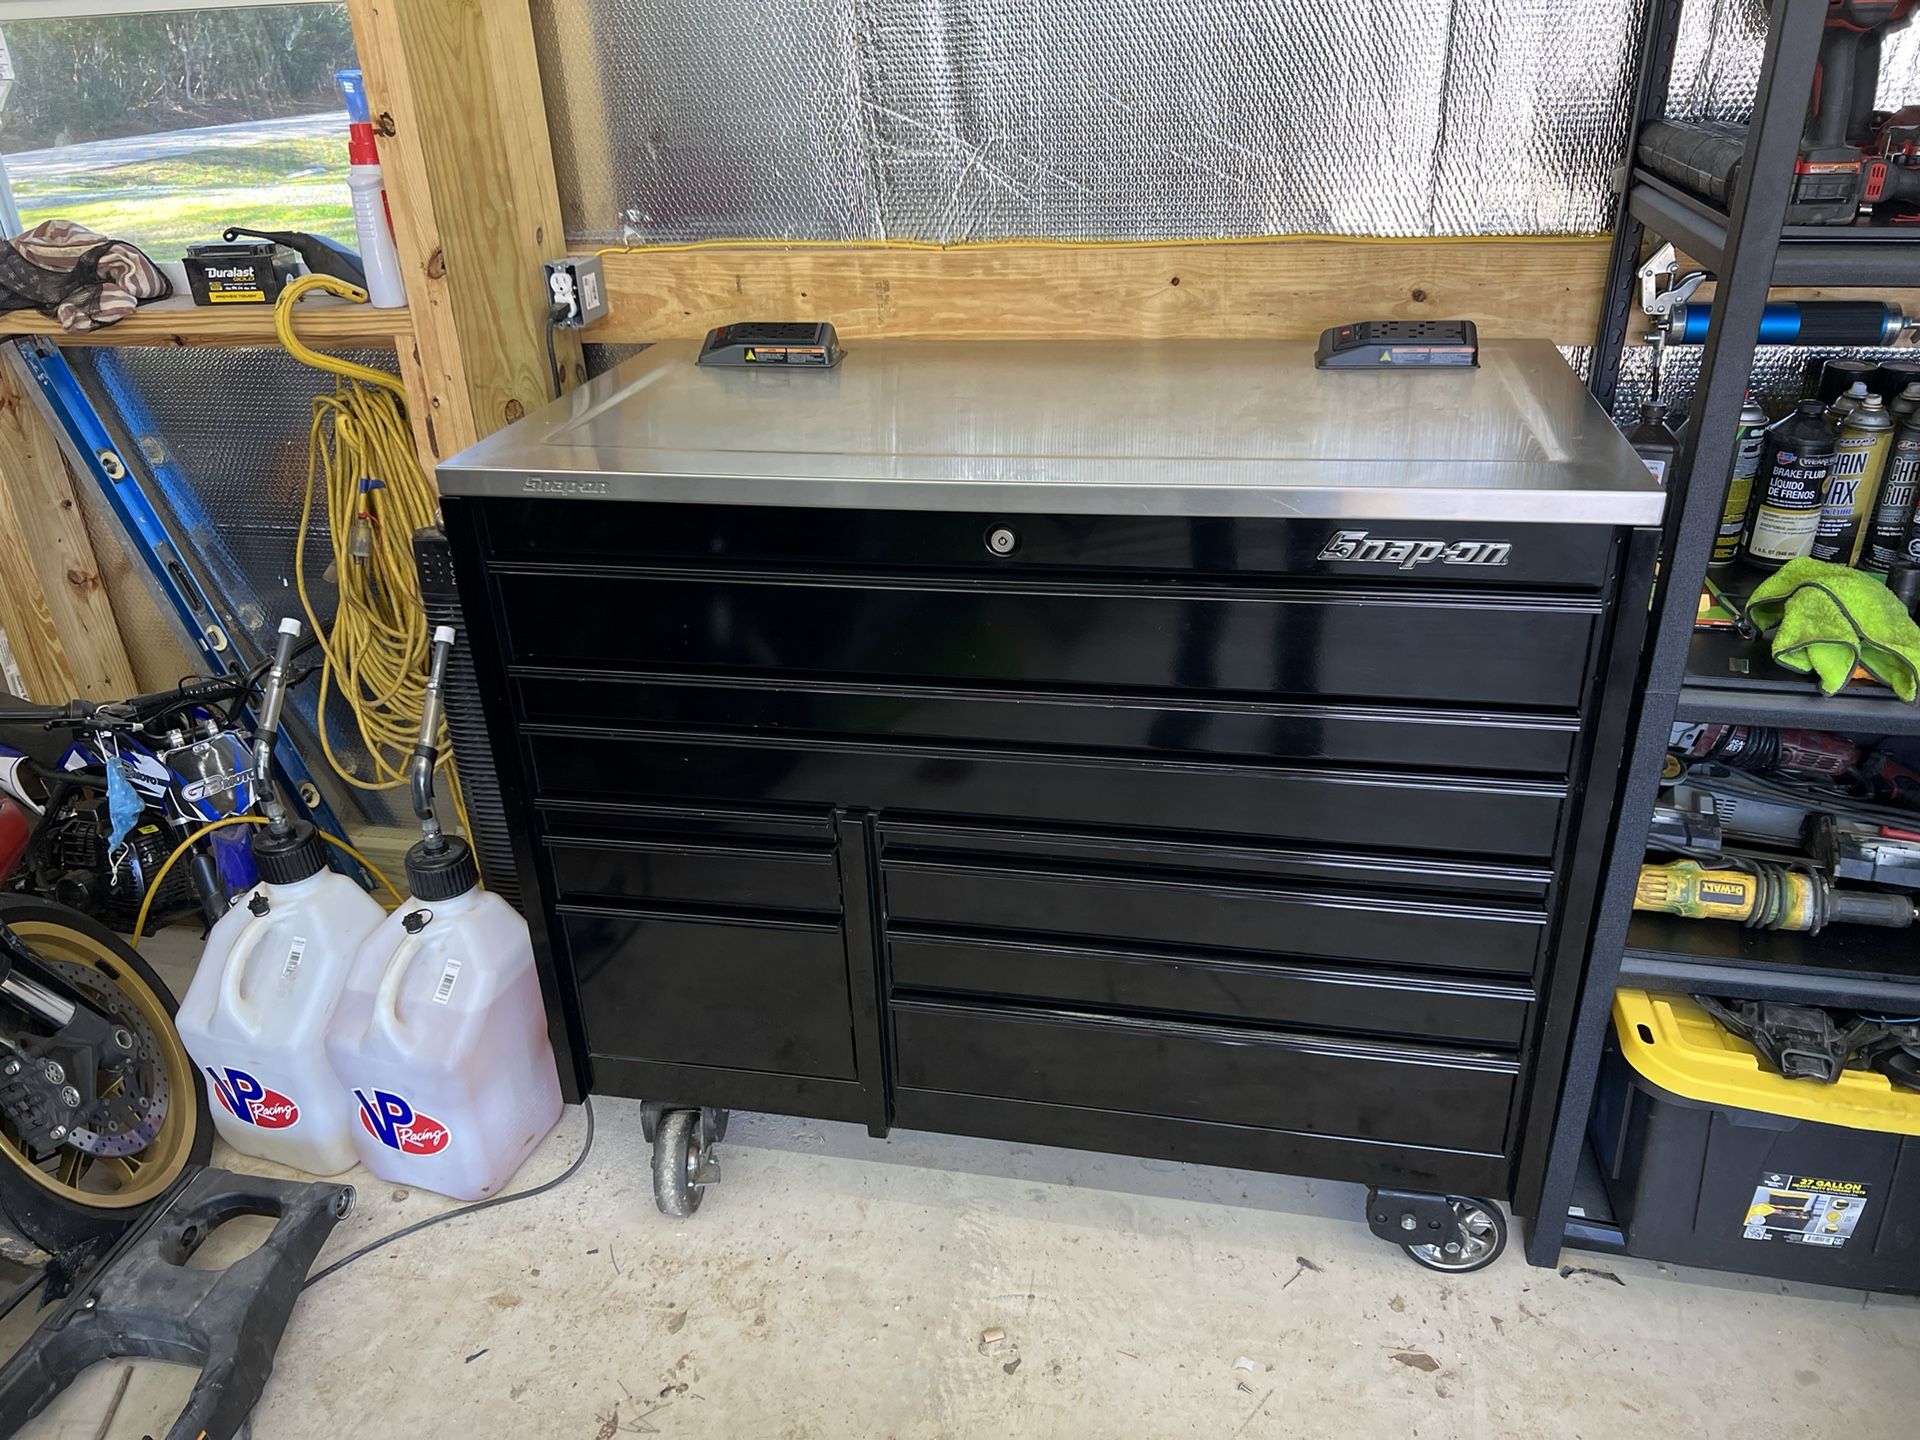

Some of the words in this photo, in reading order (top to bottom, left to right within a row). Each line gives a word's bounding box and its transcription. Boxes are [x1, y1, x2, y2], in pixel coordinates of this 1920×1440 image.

[205, 267, 255, 279] Duralast
[1772, 466, 1803, 479] BRAKE
[1803, 470, 1827, 480] FLUID
[1832, 452, 1868, 475] HAIN
[1890, 456, 1920, 482] CHA
[1767, 487, 1780, 497] DE
[1780, 489, 1816, 500] FRENOS
[1770, 477, 1805, 491] LÍQUIDO
[1823, 476, 1860, 506] AX
[1882, 483, 1914, 506] GUA
[1316, 530, 1513, 569] Snap-on
[1702, 882, 1744, 896] DEWALT
[205, 1066, 265, 1125] VP
[251, 1102, 298, 1122] Racing
[353, 1089, 416, 1151] VP
[399, 1127, 448, 1148] Racing
[1799, 1178, 1815, 1186] 27
[1816, 1180, 1862, 1191] GALLON
